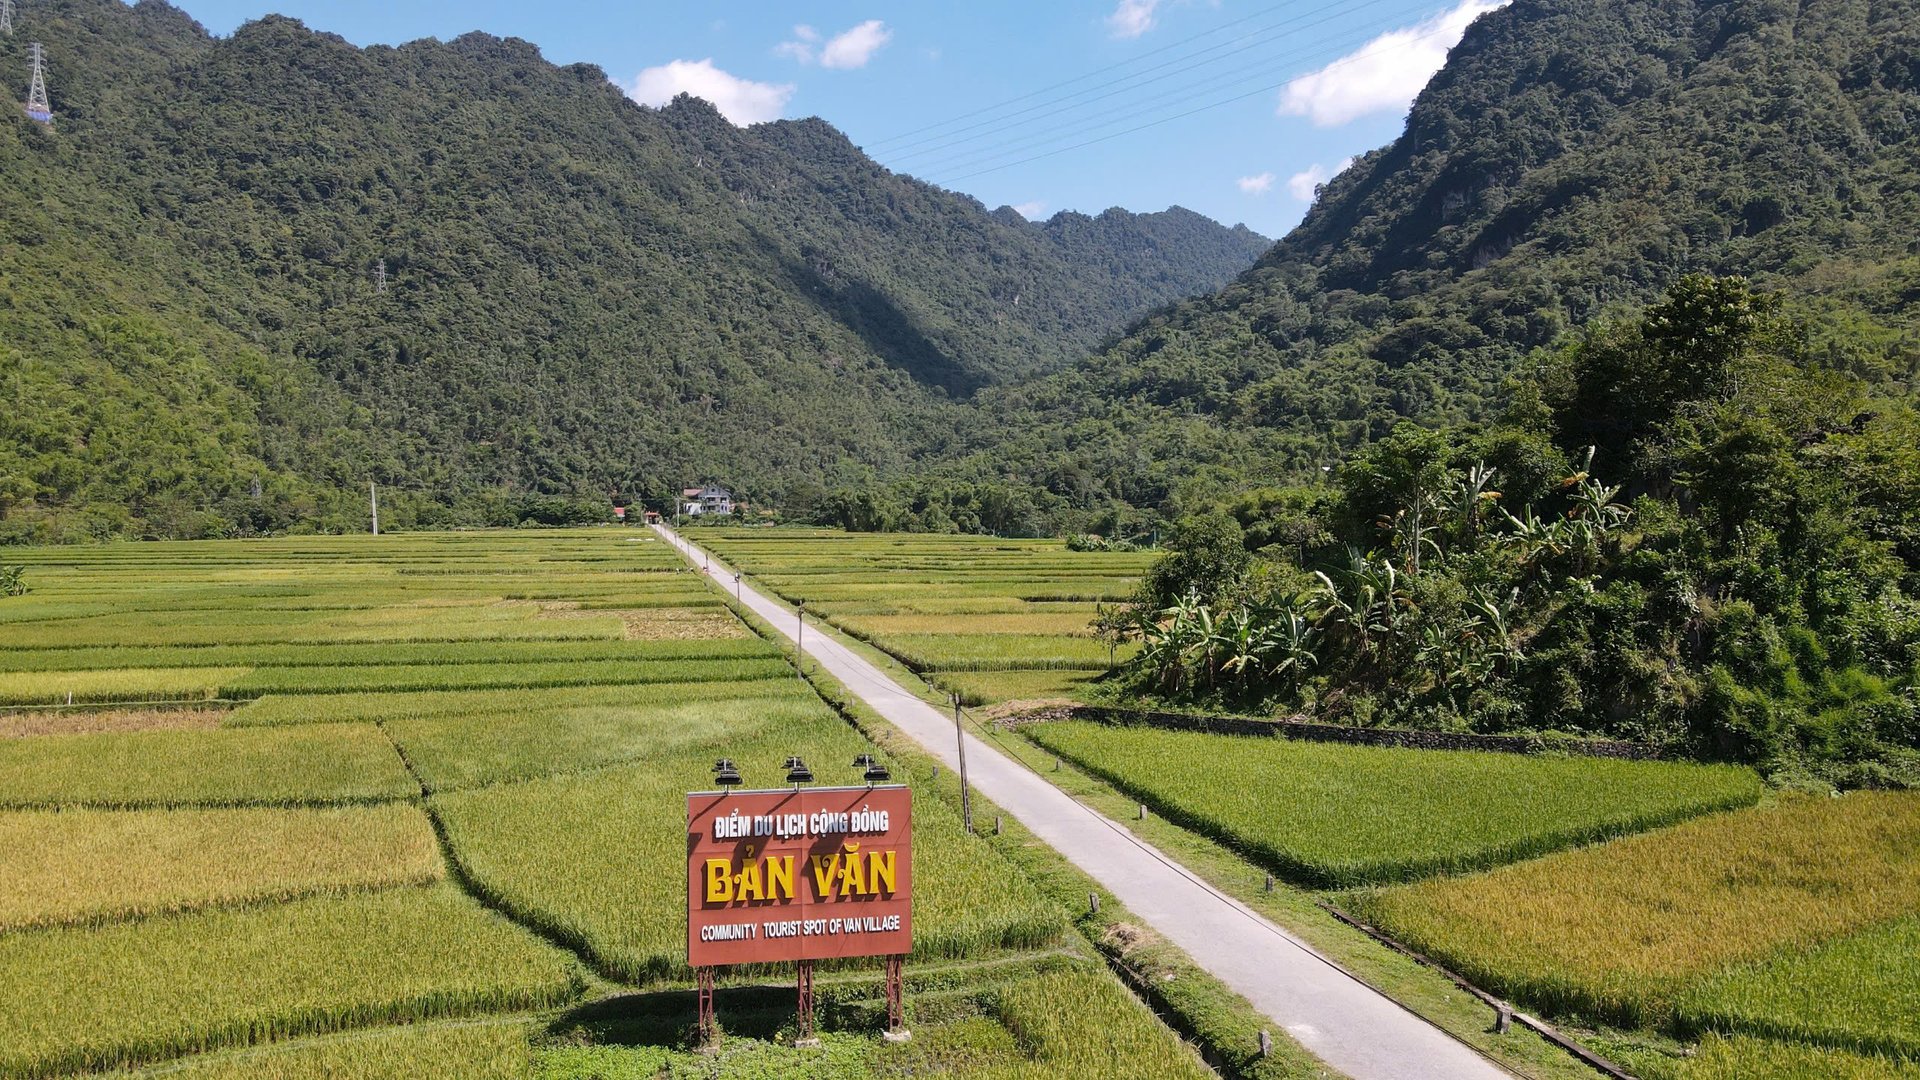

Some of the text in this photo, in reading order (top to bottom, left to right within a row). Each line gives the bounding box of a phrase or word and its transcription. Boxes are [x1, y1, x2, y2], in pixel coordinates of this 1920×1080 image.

[715, 805, 889, 839] ĐIỂM DU LỊCH CỘNG ĐỒNG
[706, 842, 896, 902] BẢN VĂN
[701, 915, 900, 941] COMMUNITY TOURIST SPOT OF VAN VILLAGE
